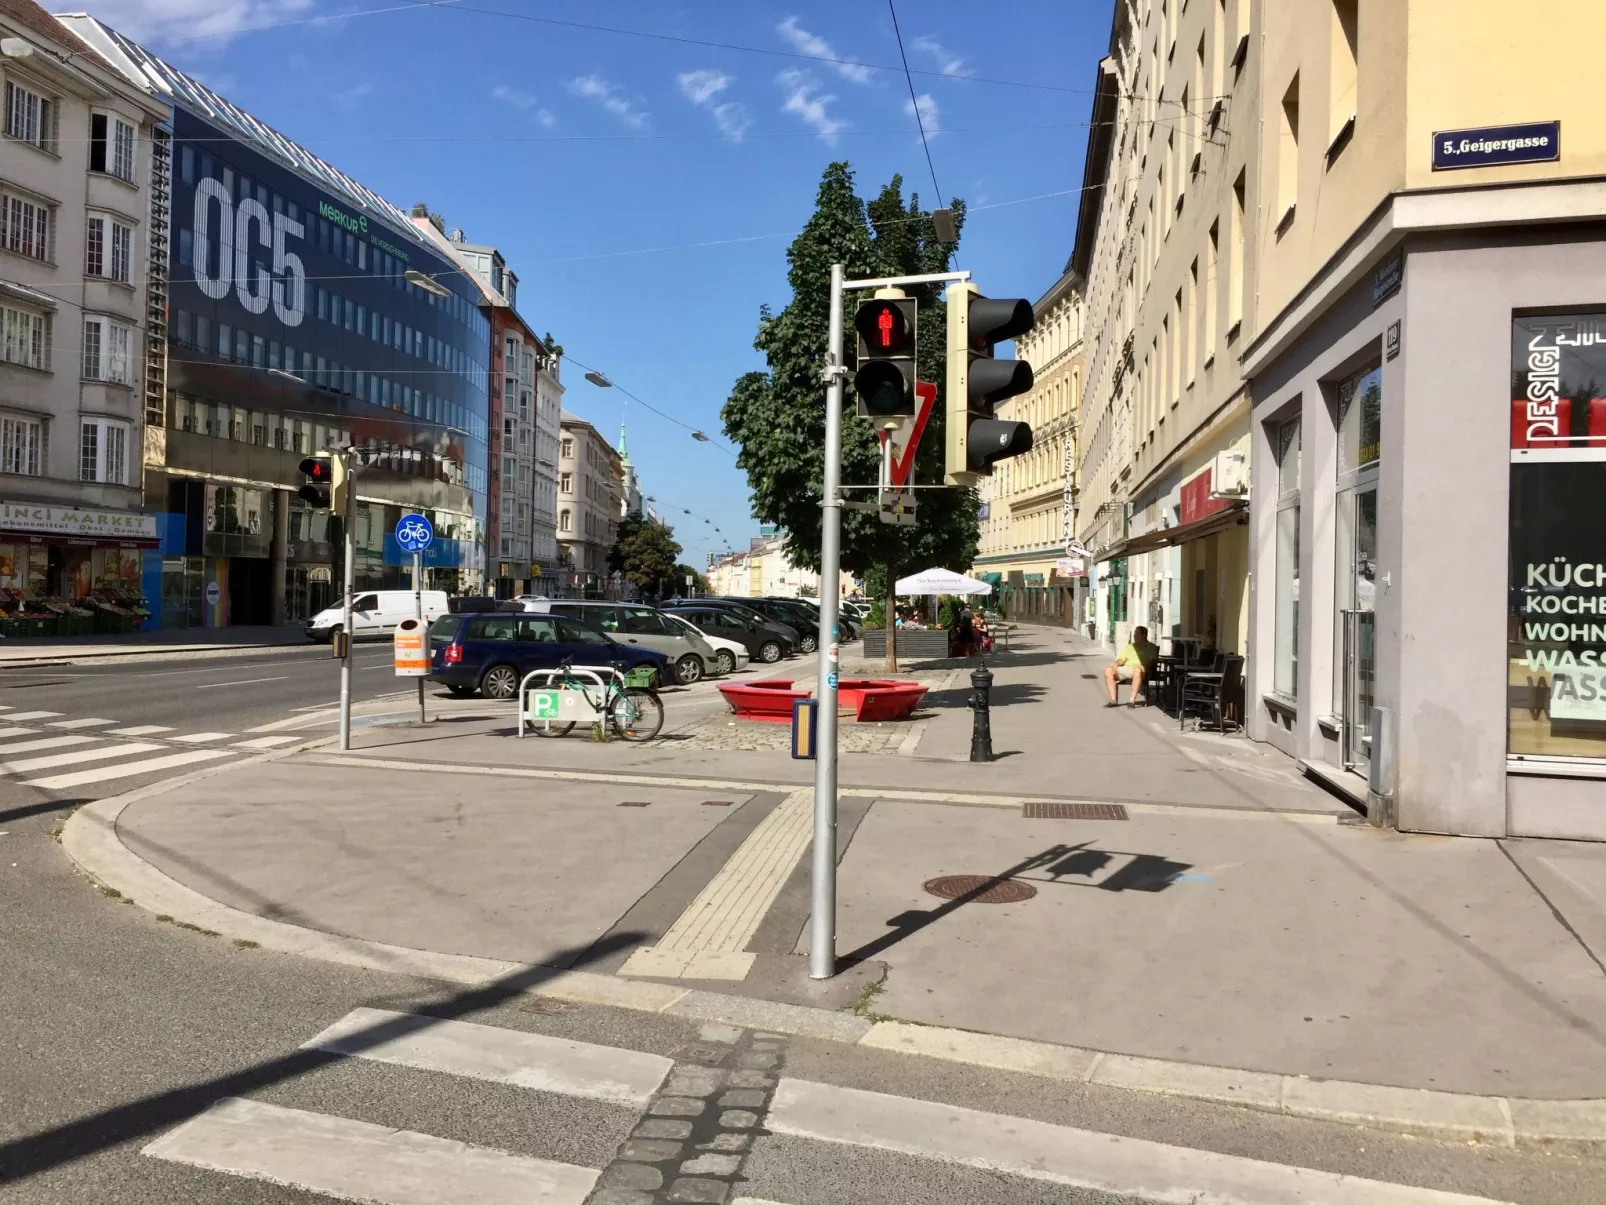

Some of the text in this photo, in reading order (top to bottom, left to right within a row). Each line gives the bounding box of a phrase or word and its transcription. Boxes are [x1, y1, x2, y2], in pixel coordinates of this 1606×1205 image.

[1388, 325, 1398, 346] 119
[0, 519, 69, 529] ebensmittel
[62, 512, 145, 528] MARKET
[1525, 623, 1606, 642] WOHN
[534, 693, 552, 716] P
